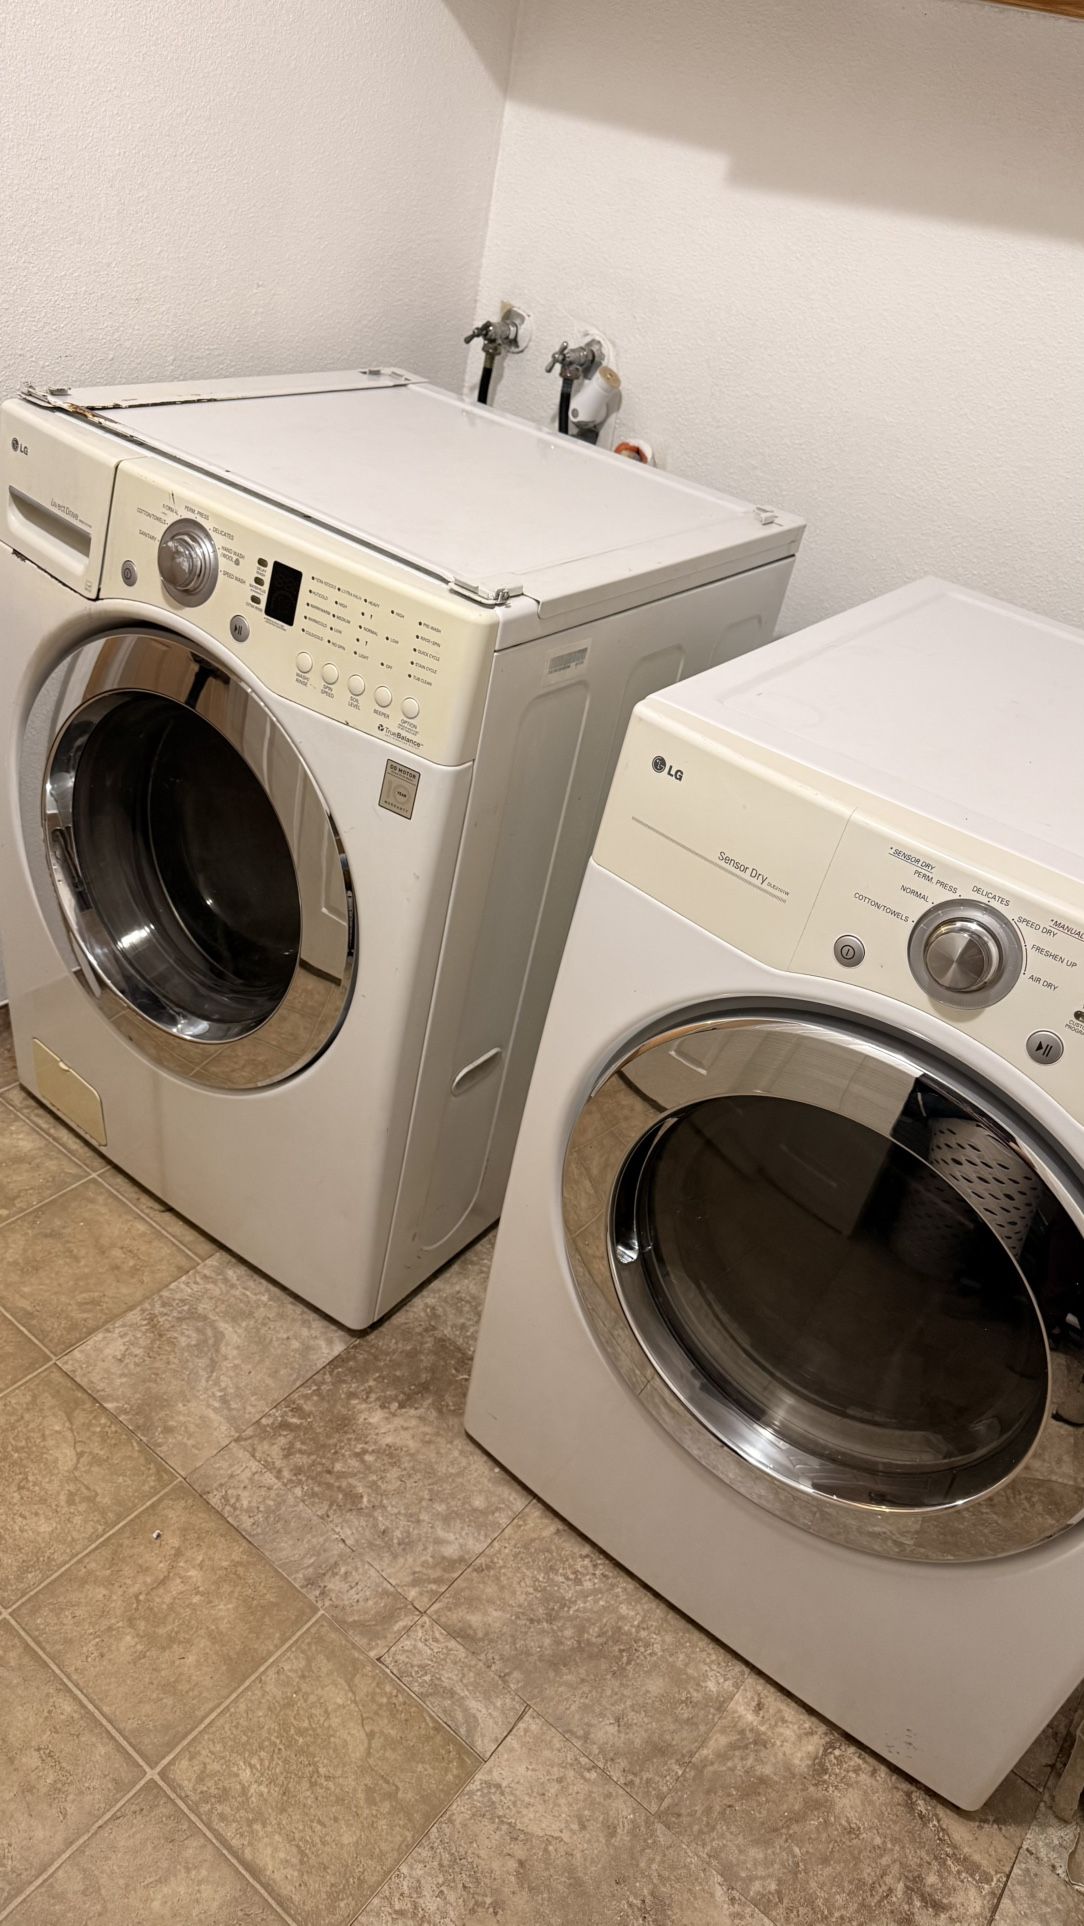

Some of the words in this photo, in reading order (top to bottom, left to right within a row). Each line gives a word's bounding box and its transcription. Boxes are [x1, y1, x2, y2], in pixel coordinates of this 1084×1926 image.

[20, 443, 28, 455] LG
[667, 765, 684, 782] LG
[718, 851, 749, 873] Sensor
[749, 868, 768, 885] Dry
[920, 861, 936, 871] DRY
[913, 869, 934, 884] PERM.
[935, 879, 958, 894] PRESS
[900, 884, 930, 903] NORMAL
[971, 885, 1011, 907] DELICATES
[854, 892, 910, 923] COTTON/TOWELS
[1017, 916, 1041, 931] SPEED
[1041, 926, 1058, 939] DRY
[1031, 944, 1065, 964] FRESHEN
[1065, 958, 1078, 969] UP
[1028, 974, 1043, 985] AIR
[1042, 979, 1059, 992] DRY
